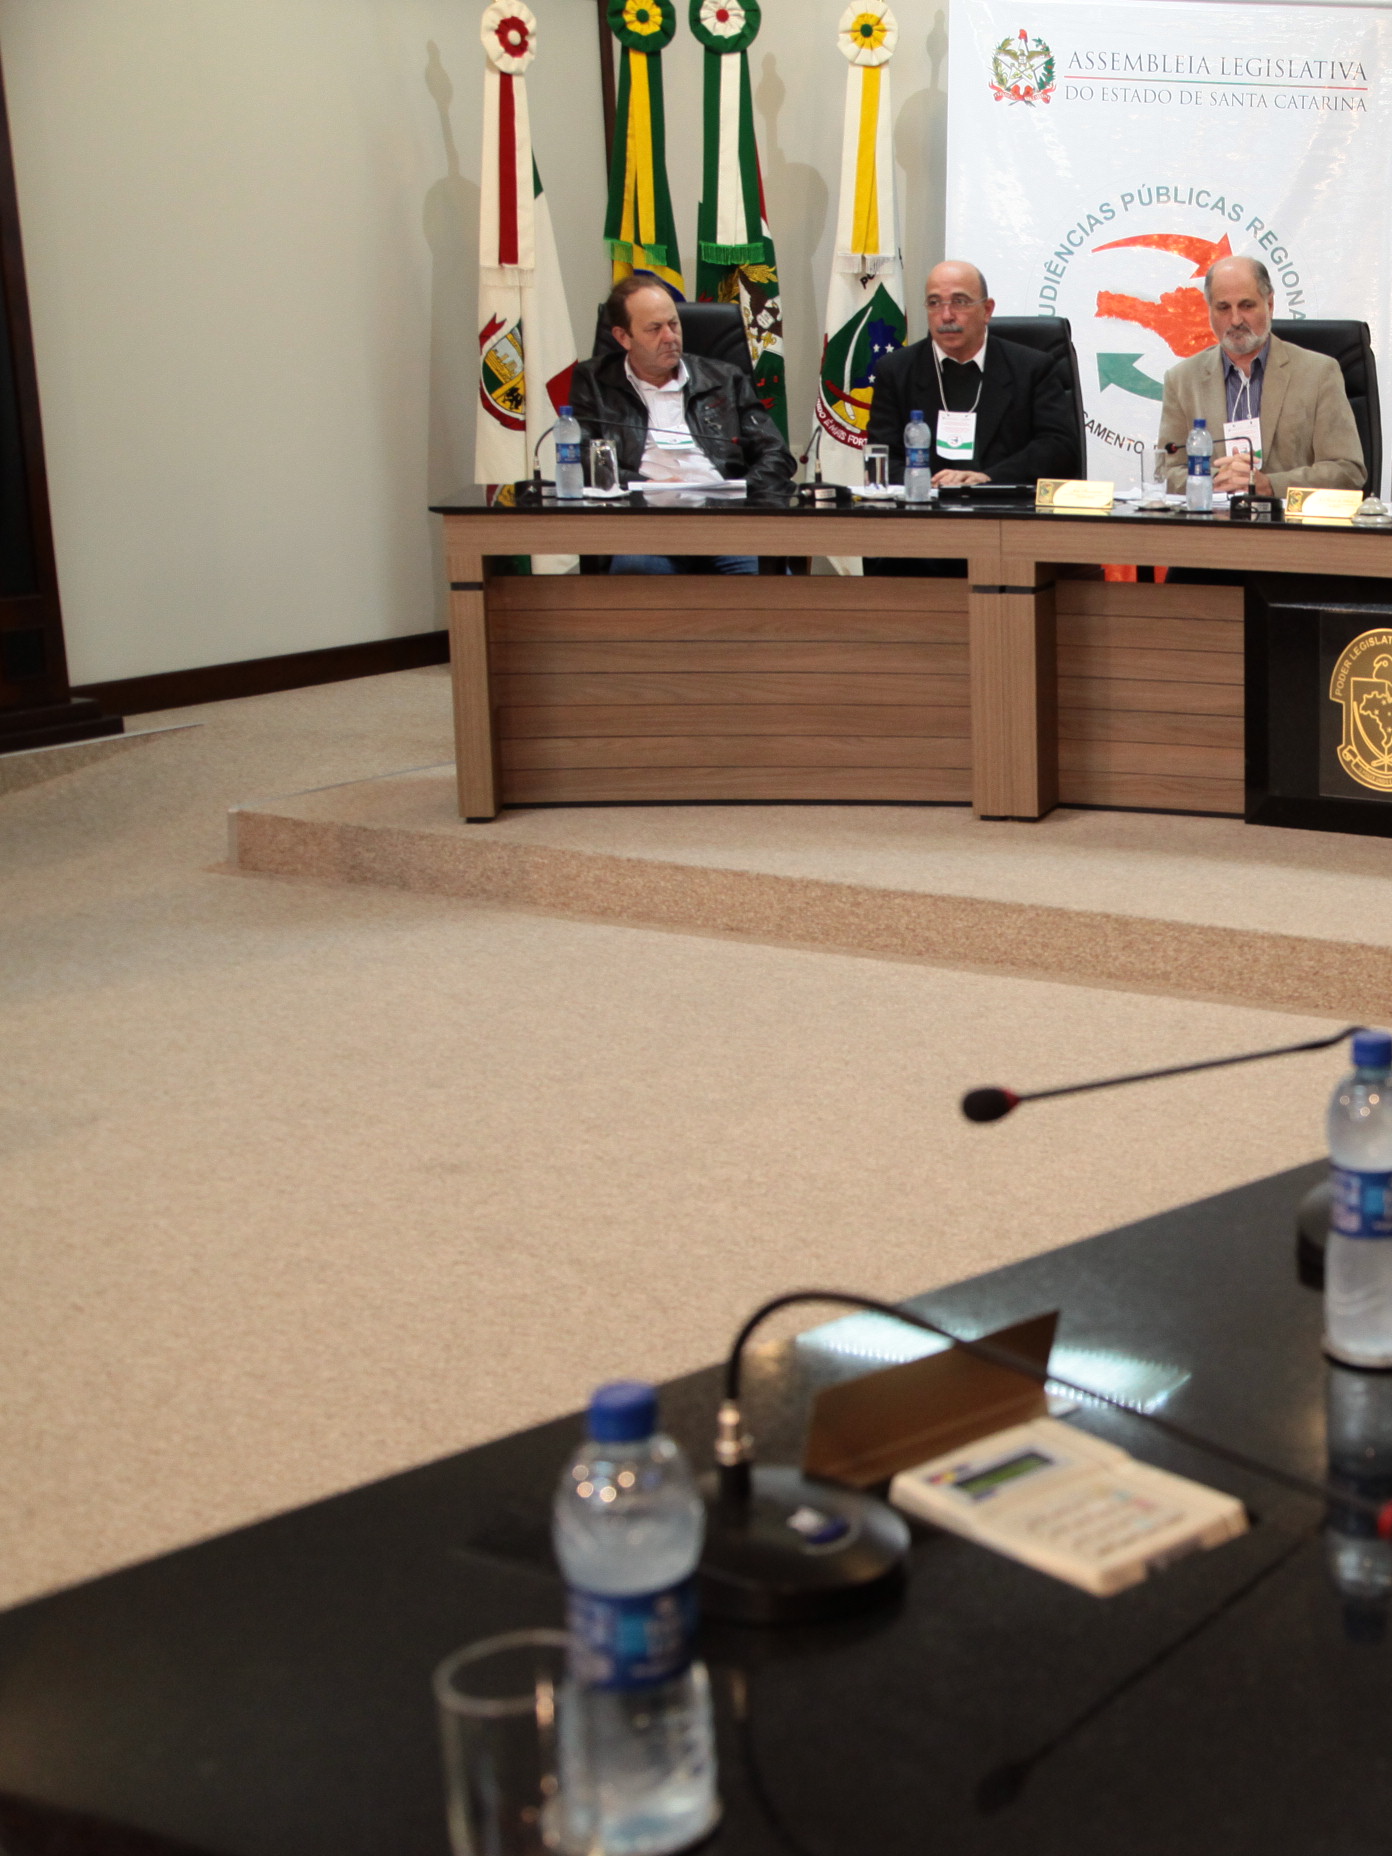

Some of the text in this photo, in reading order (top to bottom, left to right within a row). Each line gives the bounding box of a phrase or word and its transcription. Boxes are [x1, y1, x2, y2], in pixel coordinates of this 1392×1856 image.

[1068, 51, 1367, 81] ASSEMBLEIA LEGISLATIVA
[1065, 85, 1094, 101] DO
[1101, 87, 1172, 104] ESTADO
[1180, 90, 1203, 105] DE
[1210, 92, 1268, 108] SANTA
[1274, 95, 1367, 112] CATARINA
[1038, 184, 1307, 320] UDIÊNCIAS PÚBLICAS REGIONA
[1083, 411, 1145, 454] AMENTO
[1335, 659, 1352, 697] PODER
